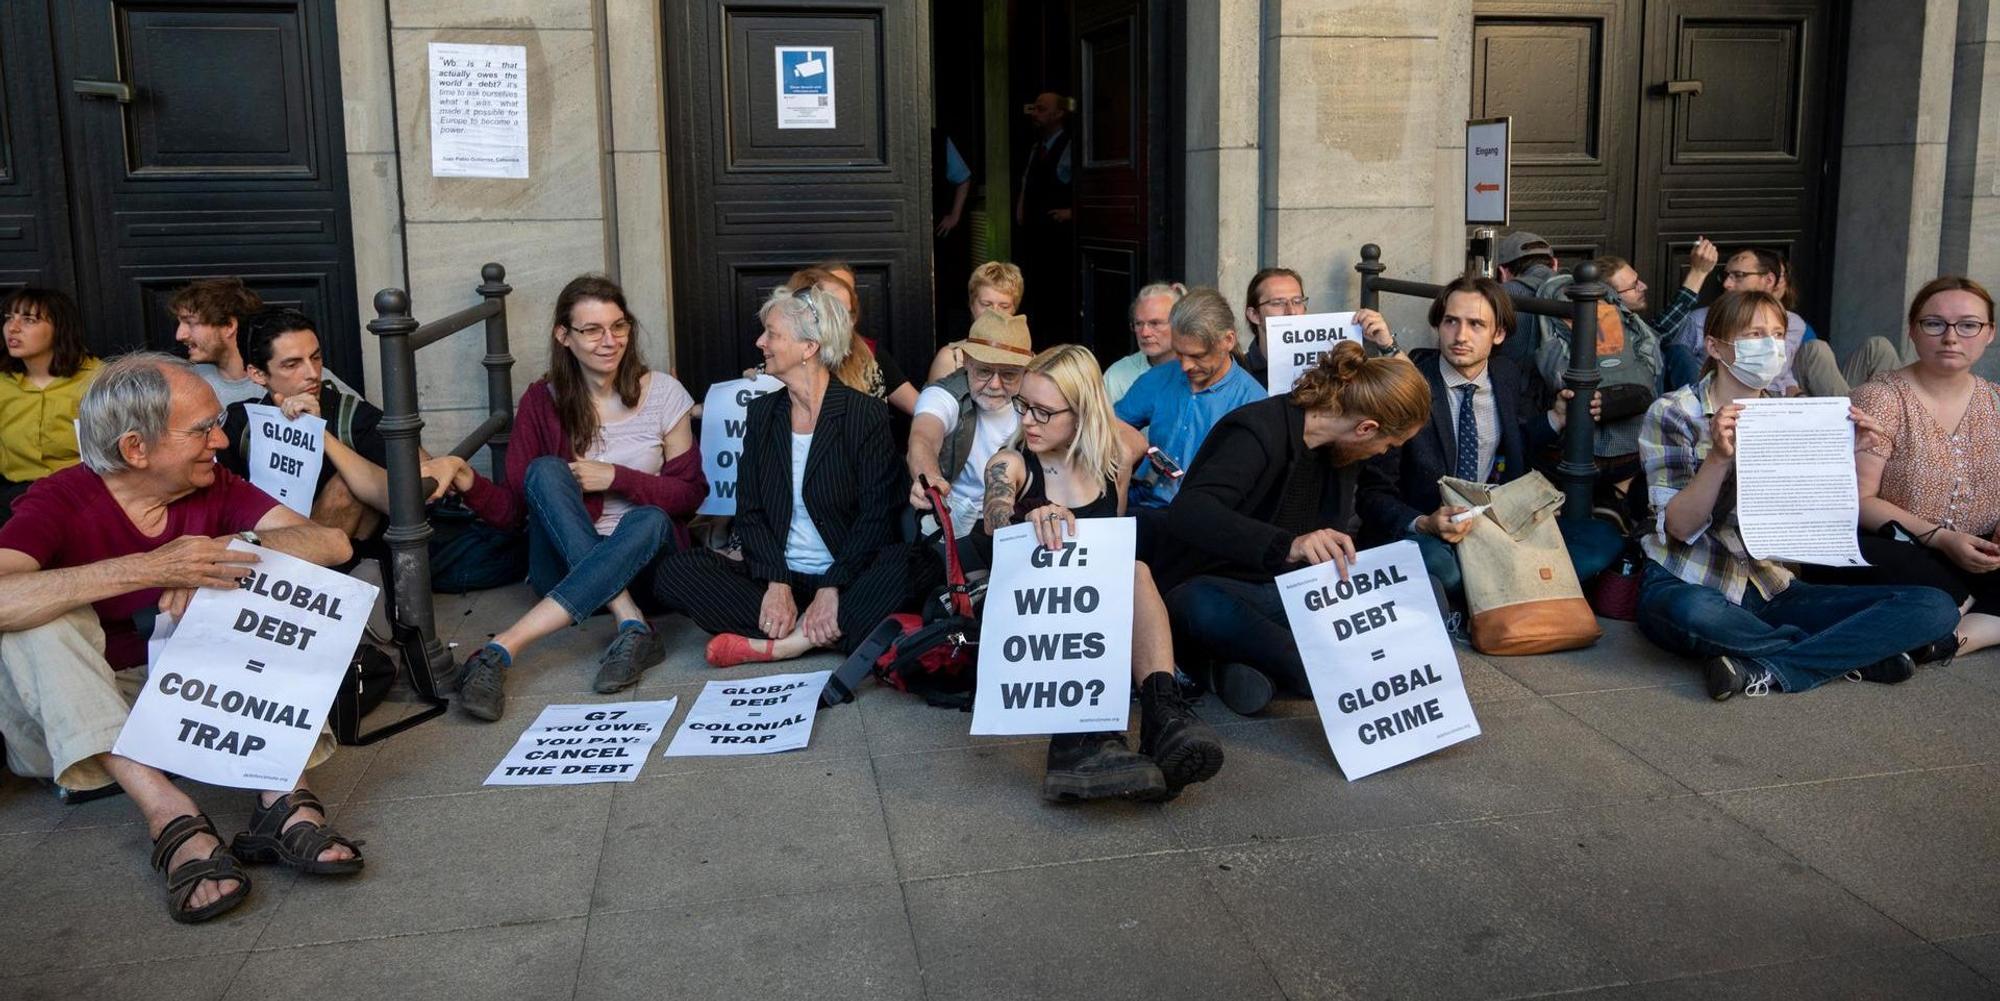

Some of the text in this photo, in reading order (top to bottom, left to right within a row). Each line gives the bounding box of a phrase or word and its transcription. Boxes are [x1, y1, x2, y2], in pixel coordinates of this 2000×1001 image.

[439, 70, 470, 78] actually
[505, 71, 518, 79] the
[440, 116, 468, 126] Europe
[474, 109, 504, 117] possible
[1475, 146, 1499, 156] Eingang
[1283, 328, 1347, 343] GLOBAL
[263, 422, 315, 452] GLOBAL
[270, 452, 303, 477] DEBT
[1031, 542, 1088, 568] G7:
[1304, 565, 1408, 612] GLOBAL
[1014, 586, 1099, 615] WHO
[233, 608, 316, 650] DEBT
[1333, 601, 1397, 641] DEBT
[1003, 632, 1105, 662] OWES
[722, 682, 808, 695] GLOBAL
[1001, 680, 1105, 709] WHO?
[1338, 664, 1442, 713] GLOBAL
[159, 673, 311, 730] COLONIAL
[729, 694, 792, 707] DEBT
[585, 710, 627, 721] G7
[689, 714, 807, 731] COLONIAL
[1358, 698, 1443, 744] CRIME
[595, 722, 652, 733] OWE,
[178, 718, 265, 756] TRAP
[536, 736, 641, 746] YOU PAY:
[710, 735, 777, 744] TRAP
[525, 747, 629, 760] CANCEL
[505, 764, 634, 776] THE DEBT
